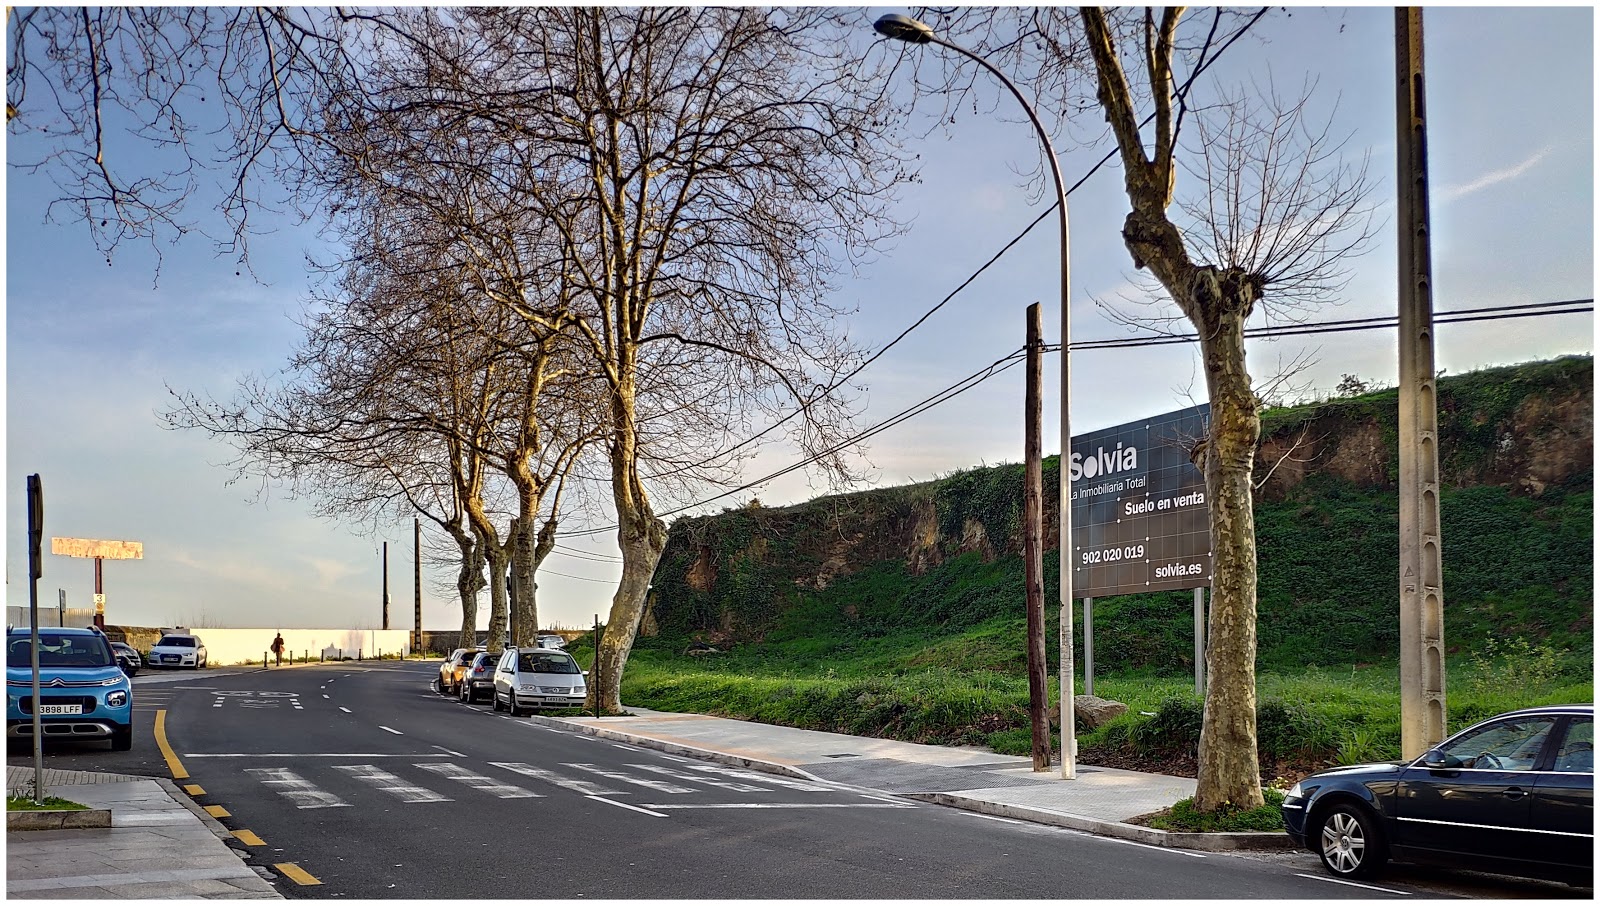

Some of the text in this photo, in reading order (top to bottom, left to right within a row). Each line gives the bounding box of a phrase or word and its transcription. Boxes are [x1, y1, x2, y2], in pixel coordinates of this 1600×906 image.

[1071, 441, 1137, 482] Solvia
[1080, 481, 1124, 499] Inmobiliaria
[1125, 475, 1146, 490] Total
[1125, 491, 1205, 516] Suelo en venta
[1082, 545, 1144, 565] 902 020 019
[1155, 562, 1202, 578] solvia.es
[40, 706, 80, 714] 3898 LFF
